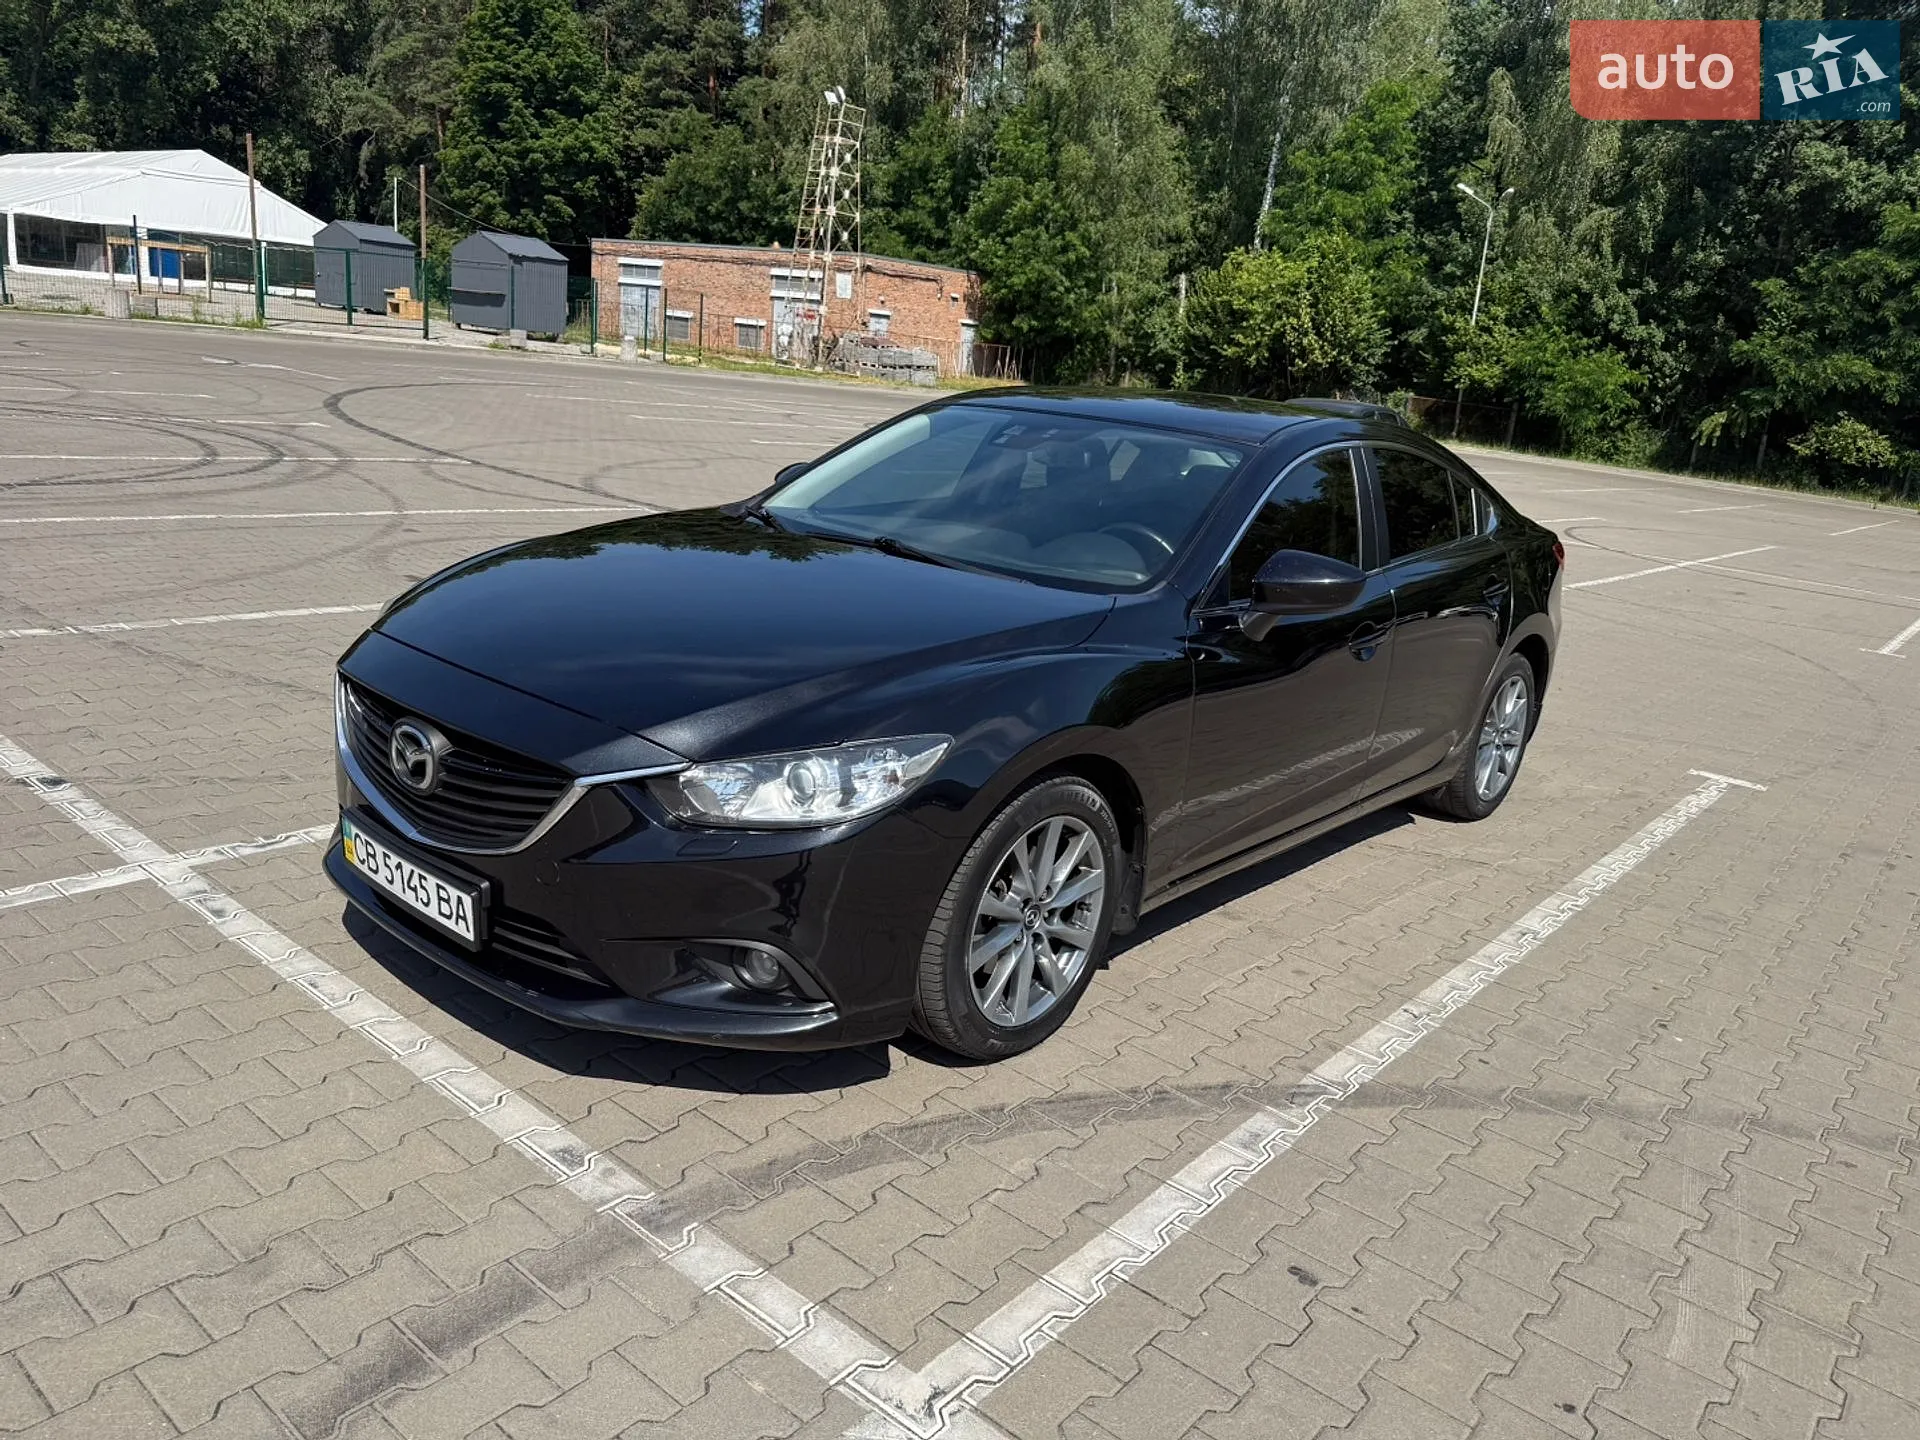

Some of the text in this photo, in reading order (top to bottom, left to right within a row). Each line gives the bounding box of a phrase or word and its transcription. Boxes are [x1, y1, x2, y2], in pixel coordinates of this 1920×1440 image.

[353, 832, 471, 934] CB 5145 BA
